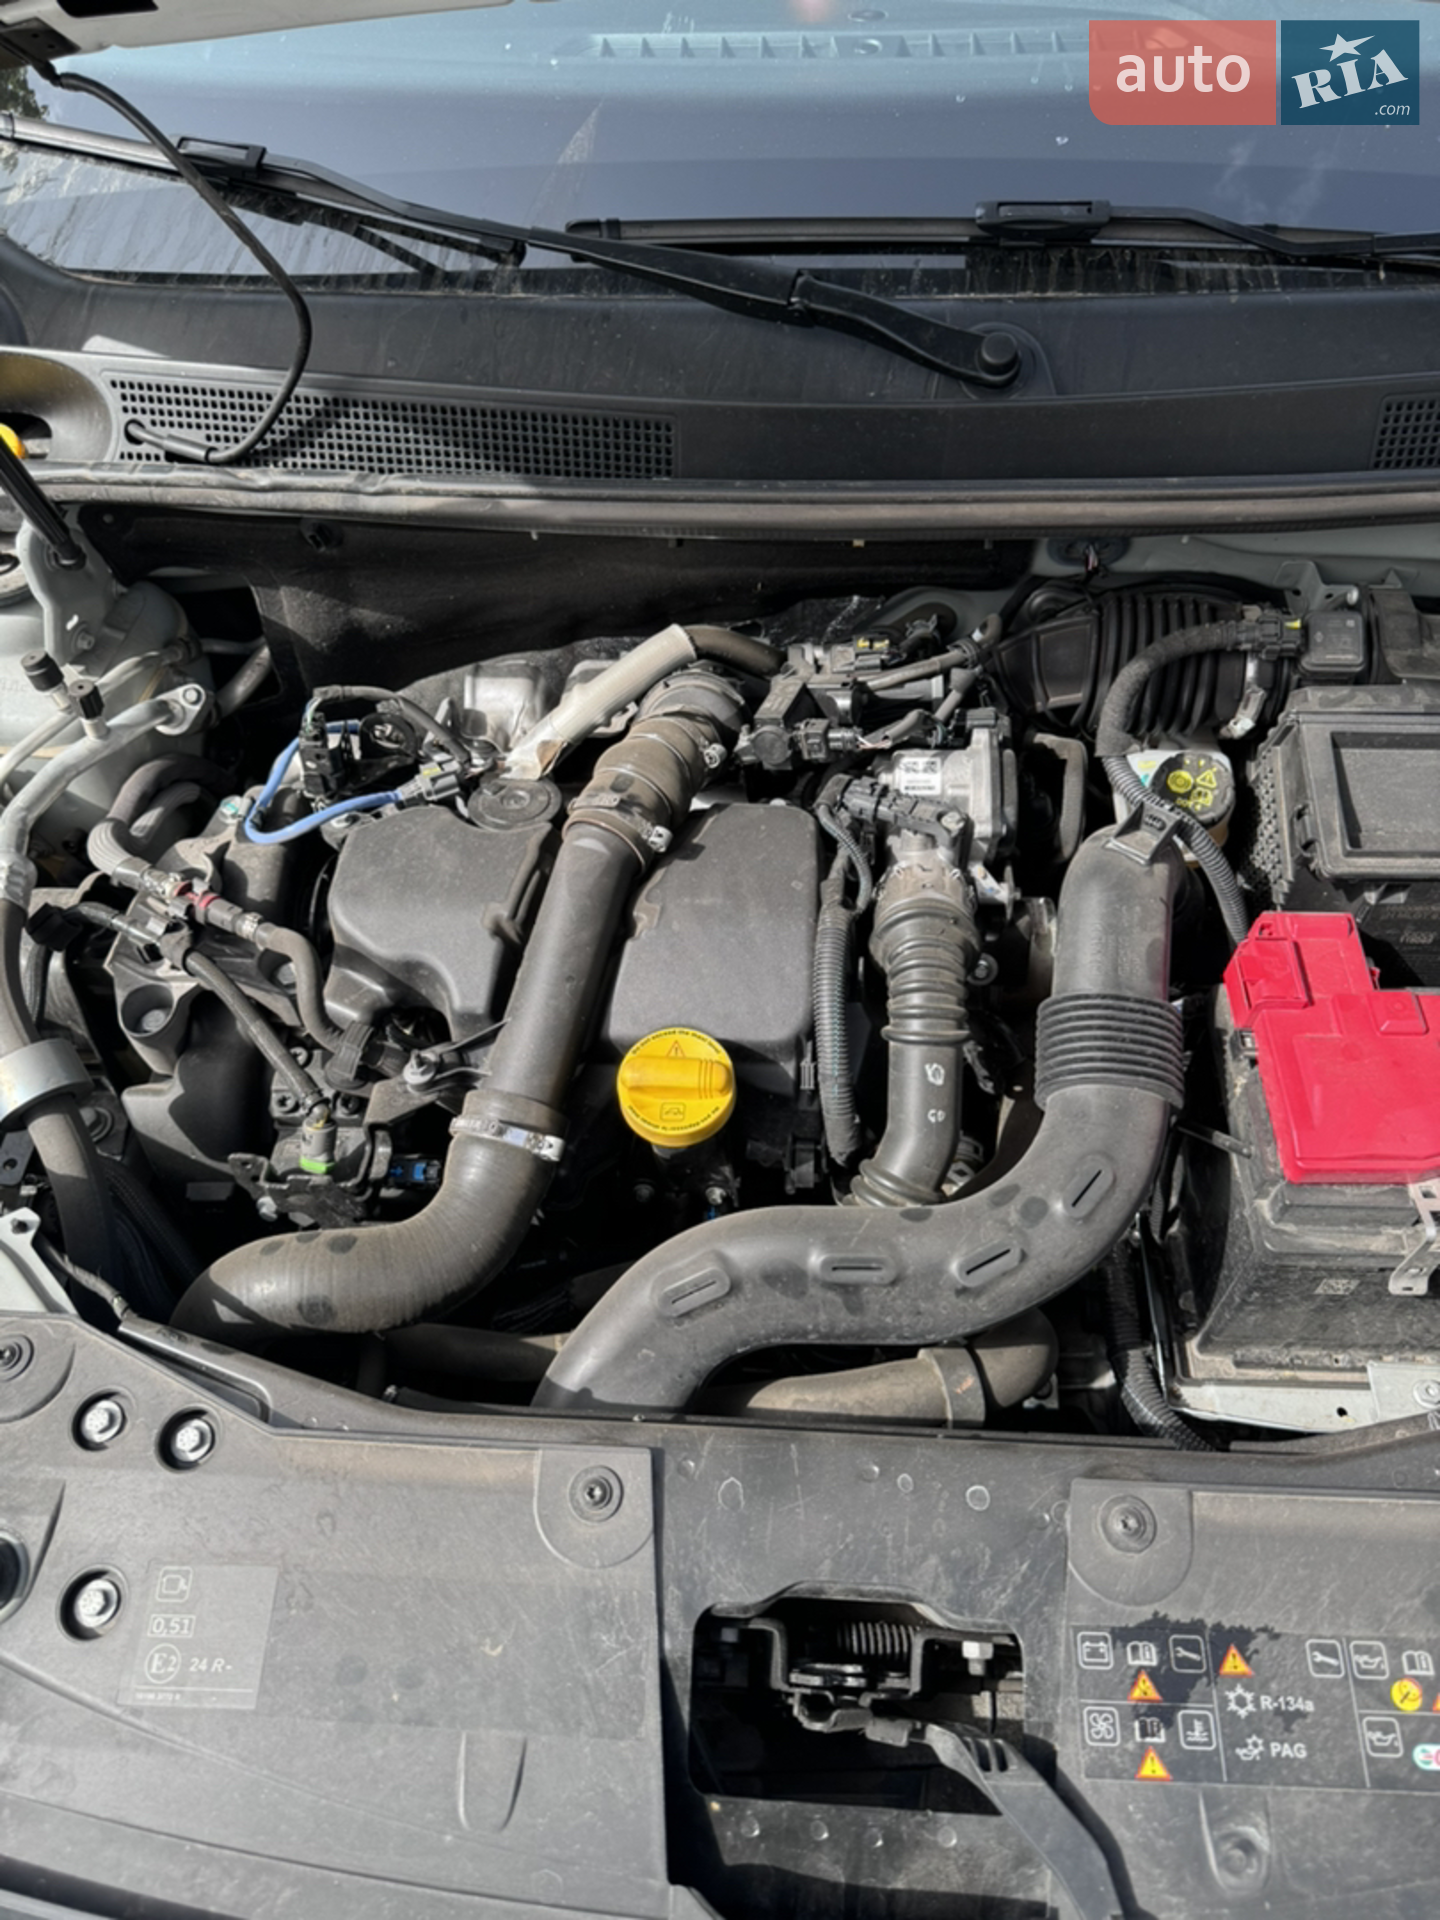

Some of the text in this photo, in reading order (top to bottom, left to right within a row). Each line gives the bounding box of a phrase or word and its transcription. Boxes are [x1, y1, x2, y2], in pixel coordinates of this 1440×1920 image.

[151, 1617, 191, 1636] 0,51
[150, 1653, 177, 1674] E2
[189, 1658, 208, 1672] 24
[1260, 1694, 1315, 1712] R-134a
[1270, 1741, 1308, 1759] PAG
